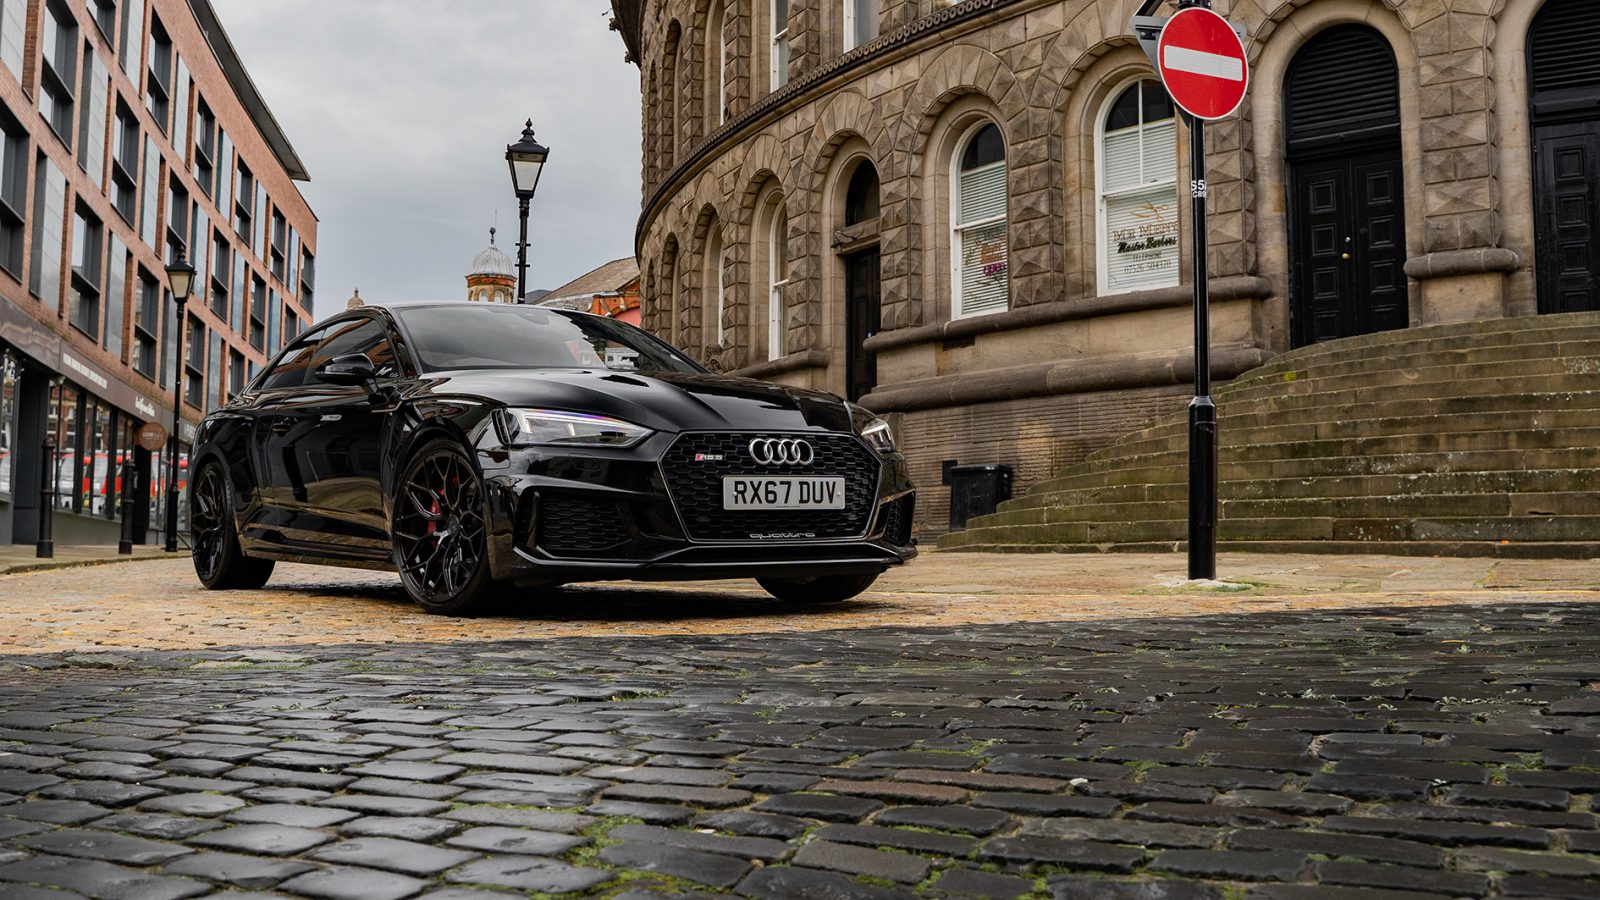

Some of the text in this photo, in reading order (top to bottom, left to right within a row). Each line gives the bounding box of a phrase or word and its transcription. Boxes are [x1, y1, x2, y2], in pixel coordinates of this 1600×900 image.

[1191, 180, 1206, 190] S5
[1117, 235, 1176, 254] Master Barbers
[734, 480, 836, 504] RX67 DUV
[749, 532, 816, 540] quattro
